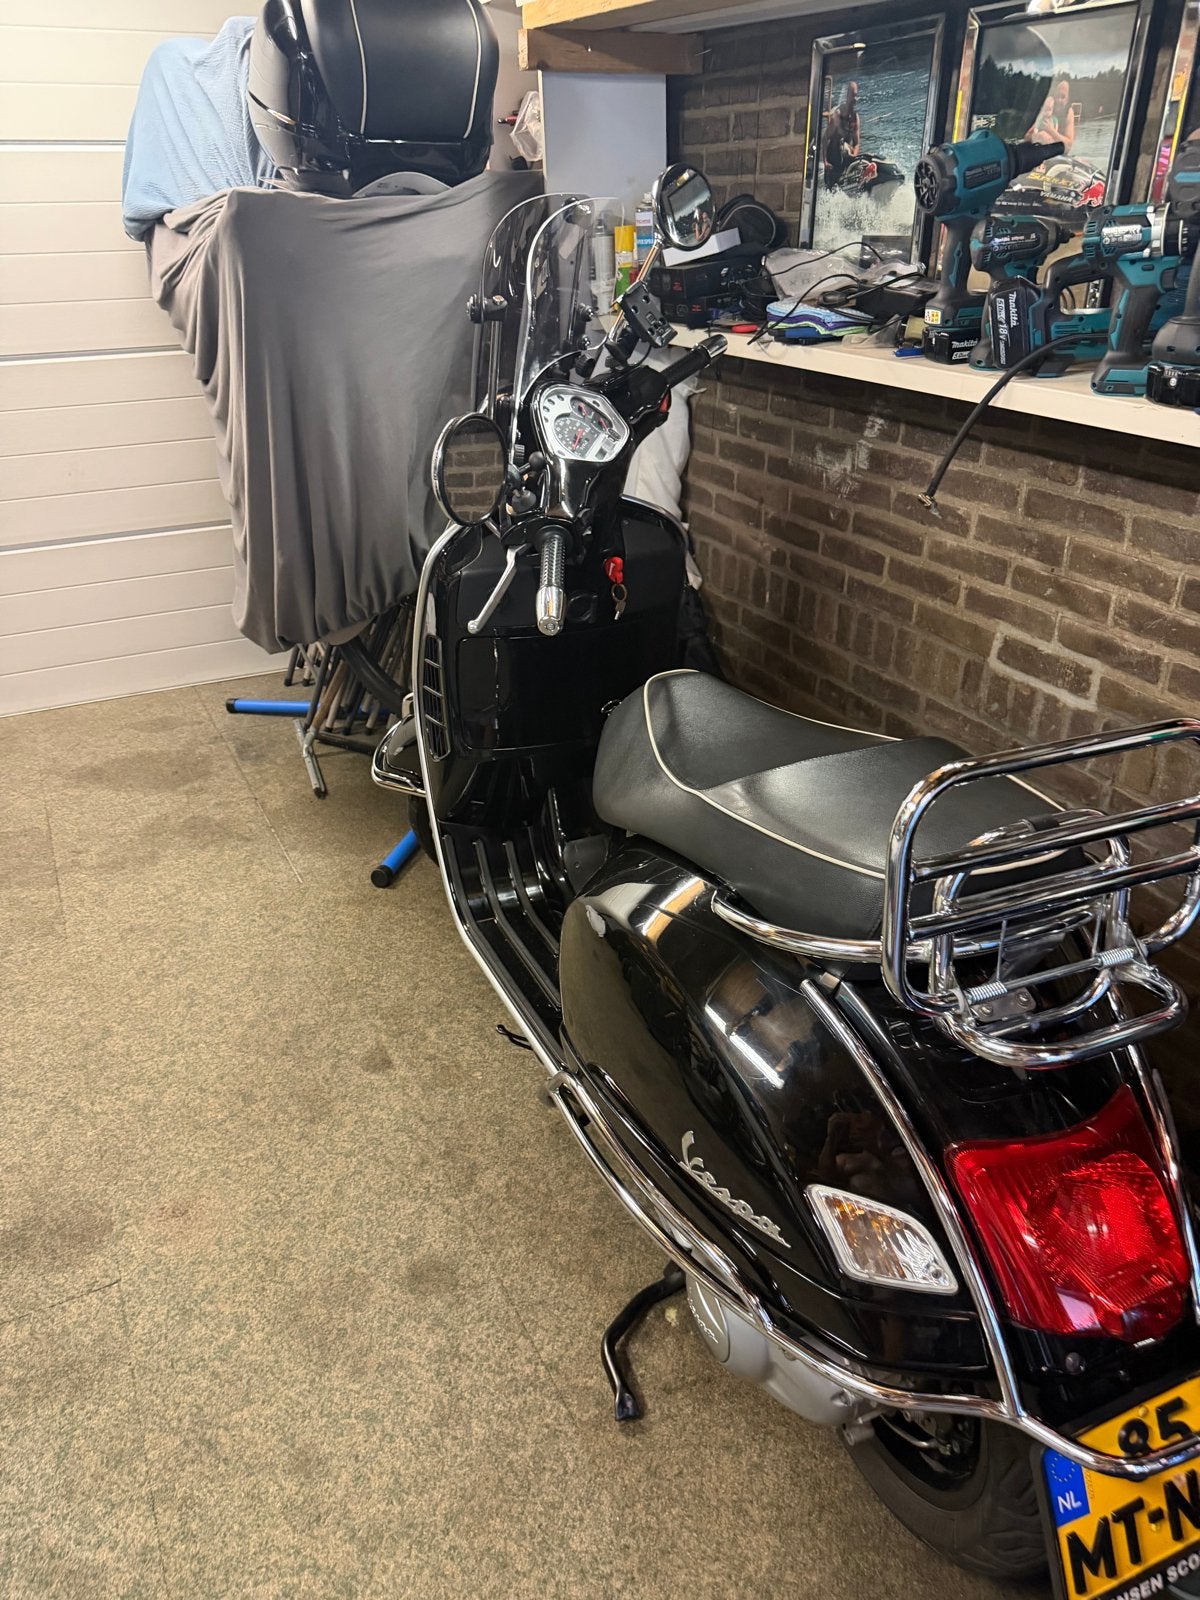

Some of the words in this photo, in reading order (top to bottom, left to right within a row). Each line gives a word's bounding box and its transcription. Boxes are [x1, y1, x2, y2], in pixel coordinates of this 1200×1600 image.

[1039, 190, 1074, 204] YAMAHA
[1057, 1490, 1082, 1514] NL
[1166, 1552, 1200, 1583] SCO
